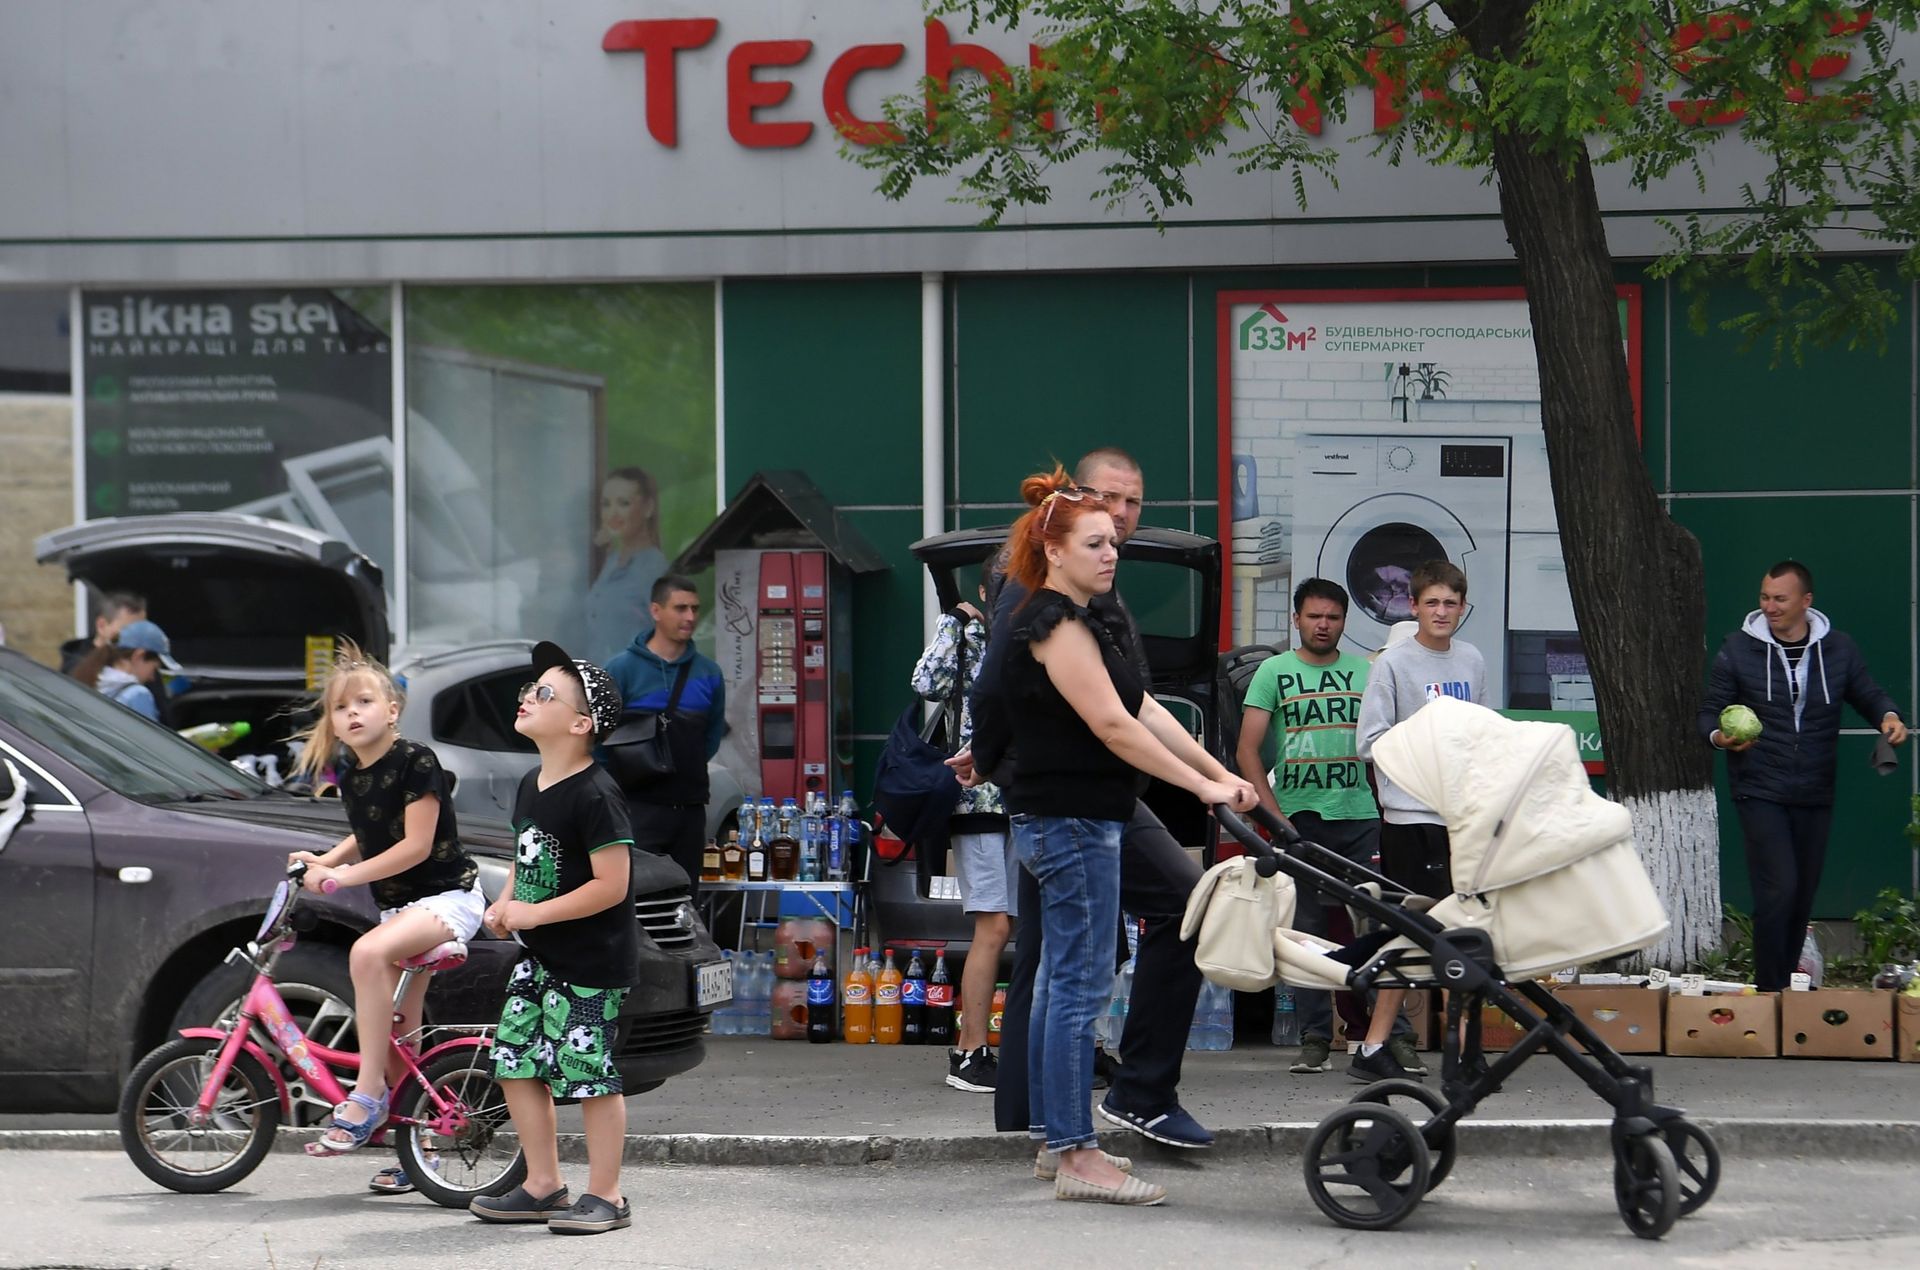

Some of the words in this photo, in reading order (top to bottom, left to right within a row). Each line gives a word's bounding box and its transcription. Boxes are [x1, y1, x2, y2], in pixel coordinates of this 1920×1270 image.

[1325, 326, 1531, 340] БУДІВЕЛЬНО-ГОСПОДАРСЬКИ
[252, 338, 306, 355] ДЛЯ
[1325, 341, 1425, 352] СУПЕРМАРКЕТ
[1277, 670, 1354, 700] PLAY
[1282, 697, 1361, 727] HARD
[1651, 970, 1666, 983] 60
[560, 1053, 601, 1077] FOOTBA
